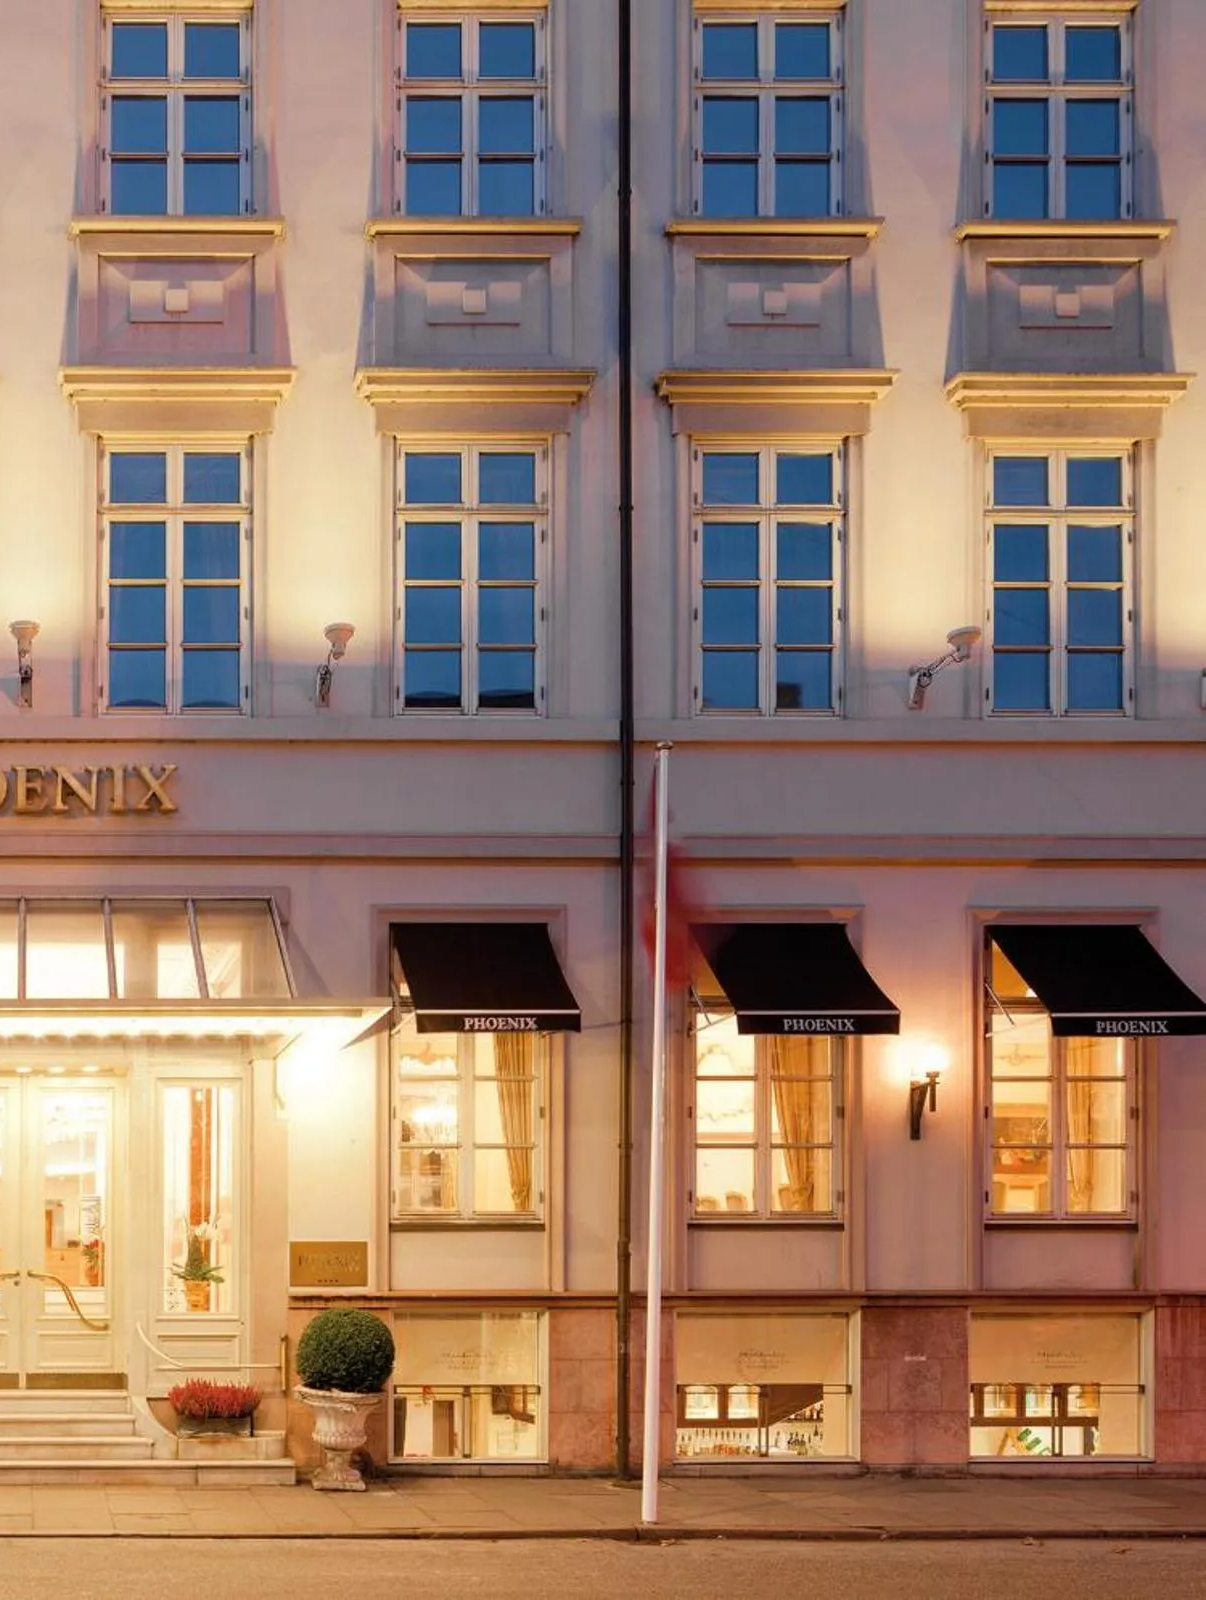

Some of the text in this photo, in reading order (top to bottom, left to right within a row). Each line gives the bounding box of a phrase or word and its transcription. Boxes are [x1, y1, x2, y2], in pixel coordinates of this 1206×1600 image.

[463, 1017, 537, 1030] PHOENIX
[783, 1018, 855, 1031] PHOENIX
[1096, 1020, 1169, 1033] PHOENIX
